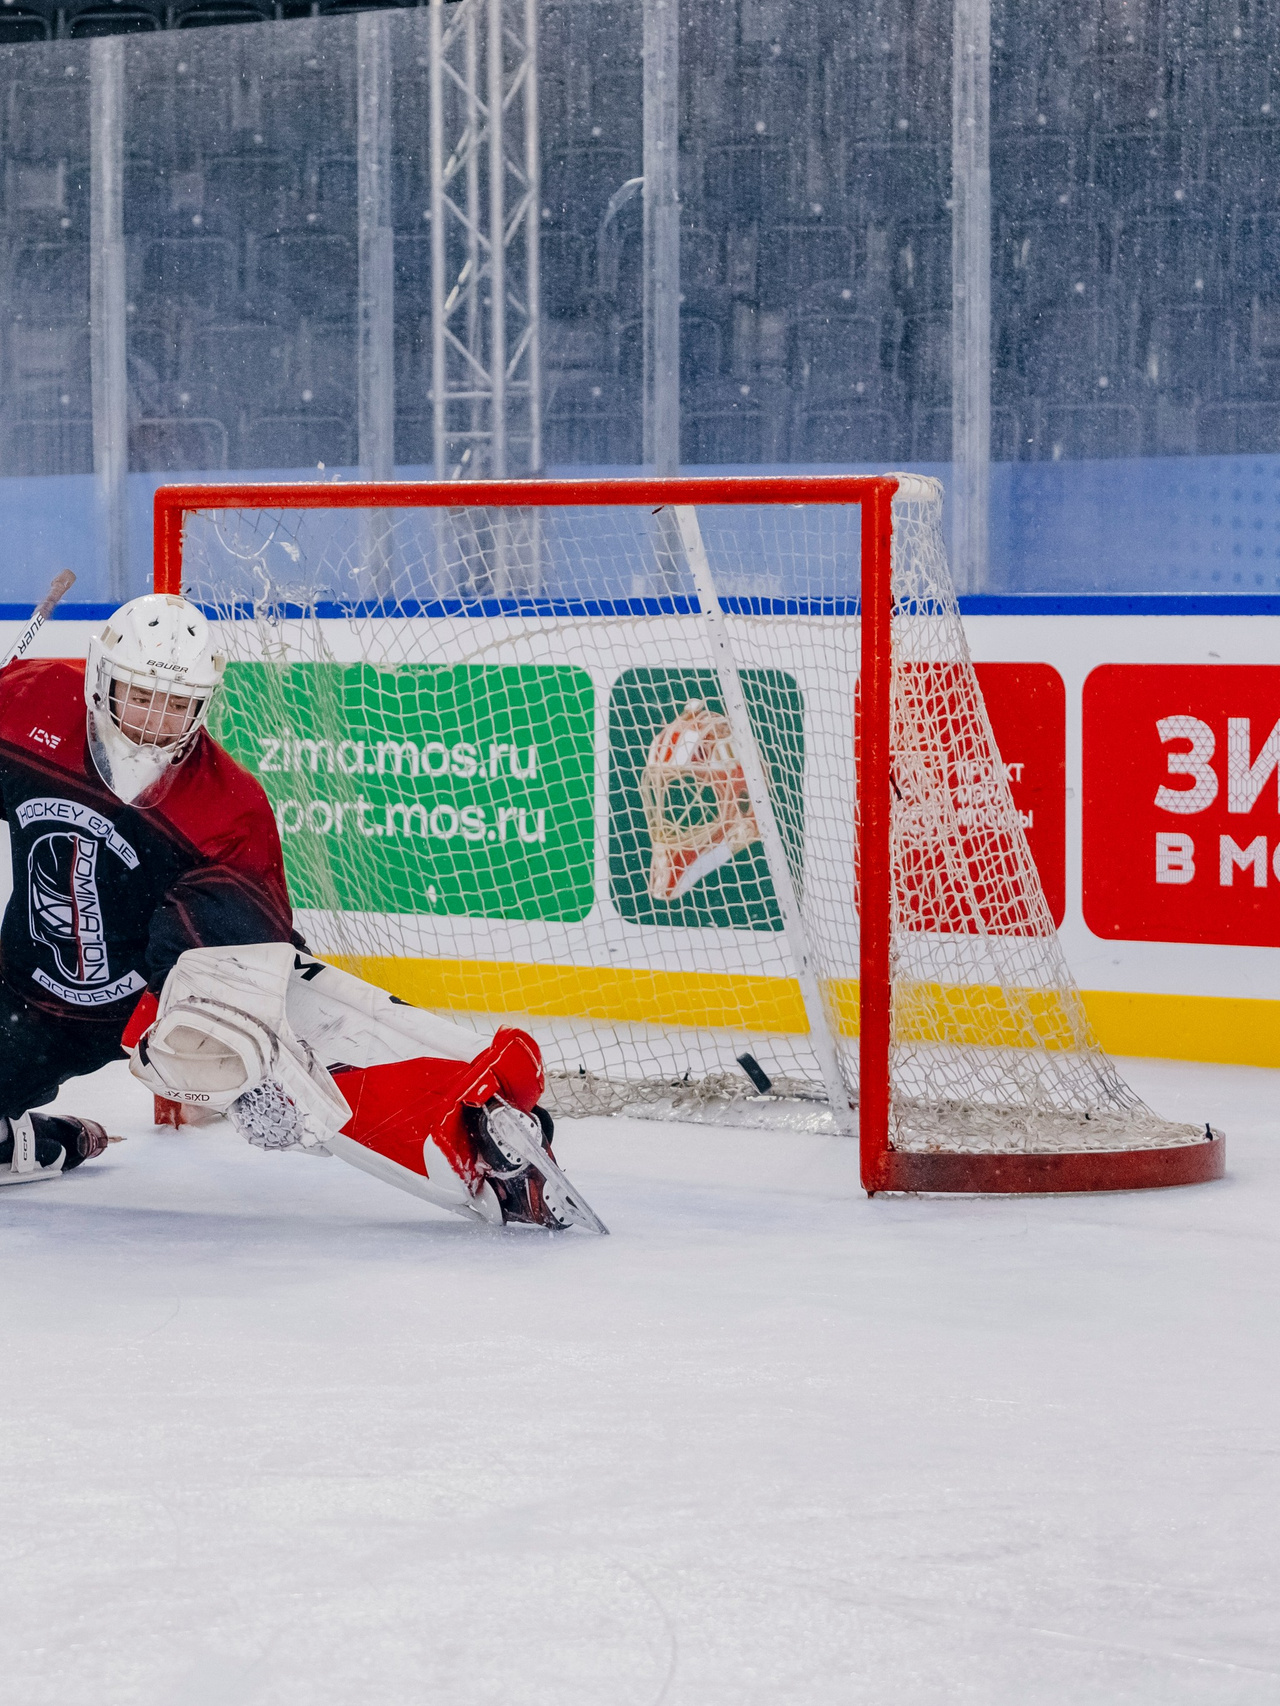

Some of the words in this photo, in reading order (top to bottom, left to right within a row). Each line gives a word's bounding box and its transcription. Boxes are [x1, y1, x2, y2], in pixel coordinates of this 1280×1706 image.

[17, 612, 45, 654] AUER
[258, 727, 538, 780] zima.mos.ru
[19, 802, 84, 826] HOCKEY
[272, 793, 547, 844] port.mos.ru
[1155, 831, 1197, 885] В
[1219, 834, 1280, 889] М
[38, 974, 134, 1003] ACADEMY
